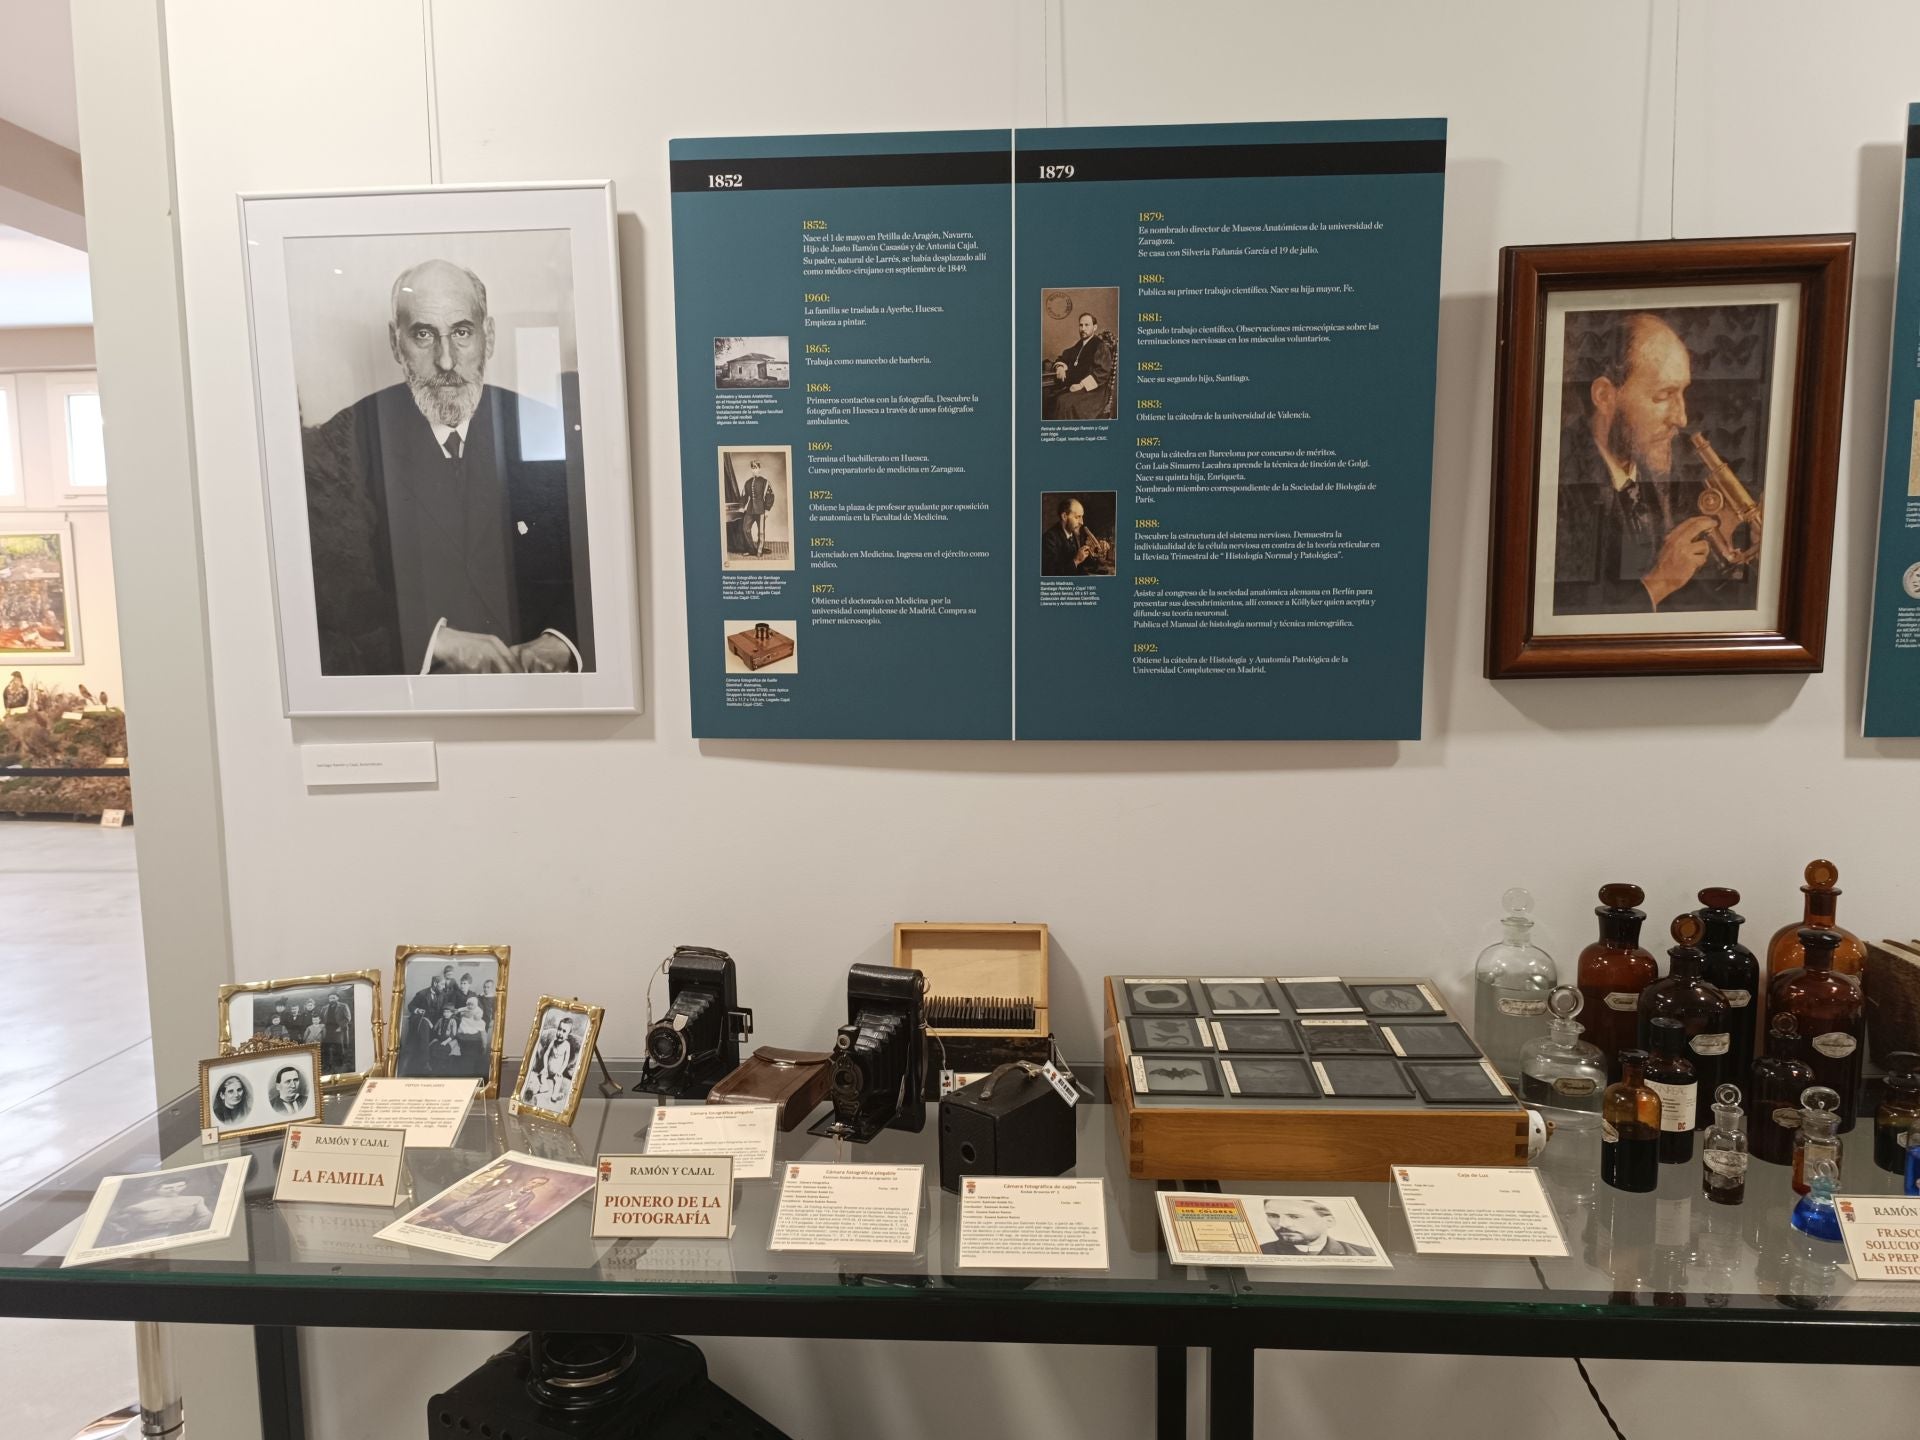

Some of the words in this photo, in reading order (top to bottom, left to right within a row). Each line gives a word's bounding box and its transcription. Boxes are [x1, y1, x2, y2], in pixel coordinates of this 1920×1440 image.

[1039, 164, 1074, 180] 1879
[708, 174, 743, 188] 1852
[1139, 213, 1164, 222] 1879:
[803, 221, 827, 229] 1852:
[877, 232, 900, 240] Petilla
[942, 231, 974, 239] Navarra.
[1138, 237, 1175, 247] Zaragoza.
[1181, 248, 1210, 256] Silveria
[1243, 247, 1269, 255] García
[1138, 274, 1165, 284] 1880:
[804, 293, 830, 302] 1960:
[814, 306, 840, 314] familia
[850, 306, 879, 314] traslada
[886, 305, 913, 315] Ayerbe,
[915, 304, 944, 313] Huesca.
[1138, 313, 1162, 322] 1881:
[804, 318, 836, 328] Empieza
[842, 318, 867, 328] pintar.
[1137, 336, 1190, 344] terminaciones
[1191, 336, 1226, 344] nerviosas
[1250, 335, 1285, 343] músculos
[1286, 335, 1331, 343] voluntarios.
[805, 344, 830, 353] 1865:
[805, 357, 832, 367] Trabaja
[855, 356, 888, 364] mancebo
[898, 356, 931, 364] barbería.
[1137, 362, 1163, 371] 1882:
[1166, 375, 1197, 384] segundo
[1215, 374, 1250, 384] Santiago.
[806, 383, 831, 392] 1868:
[1137, 400, 1162, 409] 1883:
[808, 441, 832, 450] 1869:
[1136, 437, 1161, 446] 1887:
[846, 454, 889, 462] bachillerato
[830, 466, 875, 475] preparatorio
[930, 465, 965, 474] Zaragoza.
[1164, 473, 1188, 482] quinta
[1207, 472, 1246, 482] Enriqueta.
[809, 490, 832, 499] 1872:
[1135, 495, 1155, 503] París.
[1135, 519, 1160, 528] 1888:
[810, 537, 834, 546] 1873:
[810, 560, 838, 568] médico.
[1134, 576, 1159, 585] 1889:
[812, 584, 834, 593] 1877:
[812, 617, 836, 626] primer
[837, 616, 882, 626] microscopio.
[1133, 643, 1158, 652] 1892:
[1176, 666, 1225, 675] Complutense
[315, 1136, 350, 1146] RAMÓN
[360, 1139, 389, 1148] CAJAL
[630, 1165, 669, 1176] RAMÓN
[672, 1167, 679, 1176] Y
[681, 1167, 714, 1176] CAJAL
[292, 1169, 312, 1182] LA
[317, 1170, 384, 1186] FAMILIA
[605, 1195, 673, 1208] PIONERO
[677, 1196, 698, 1208] DE
[702, 1196, 721, 1208] LA
[1873, 1206, 1918, 1216] RAMÓN
[612, 1210, 711, 1225] FOTOGRAFÍA
[1866, 1240, 1920, 1250] SOLUCIO
[1863, 1253, 1885, 1262] LAS
[1888, 1253, 1920, 1262] PREP
